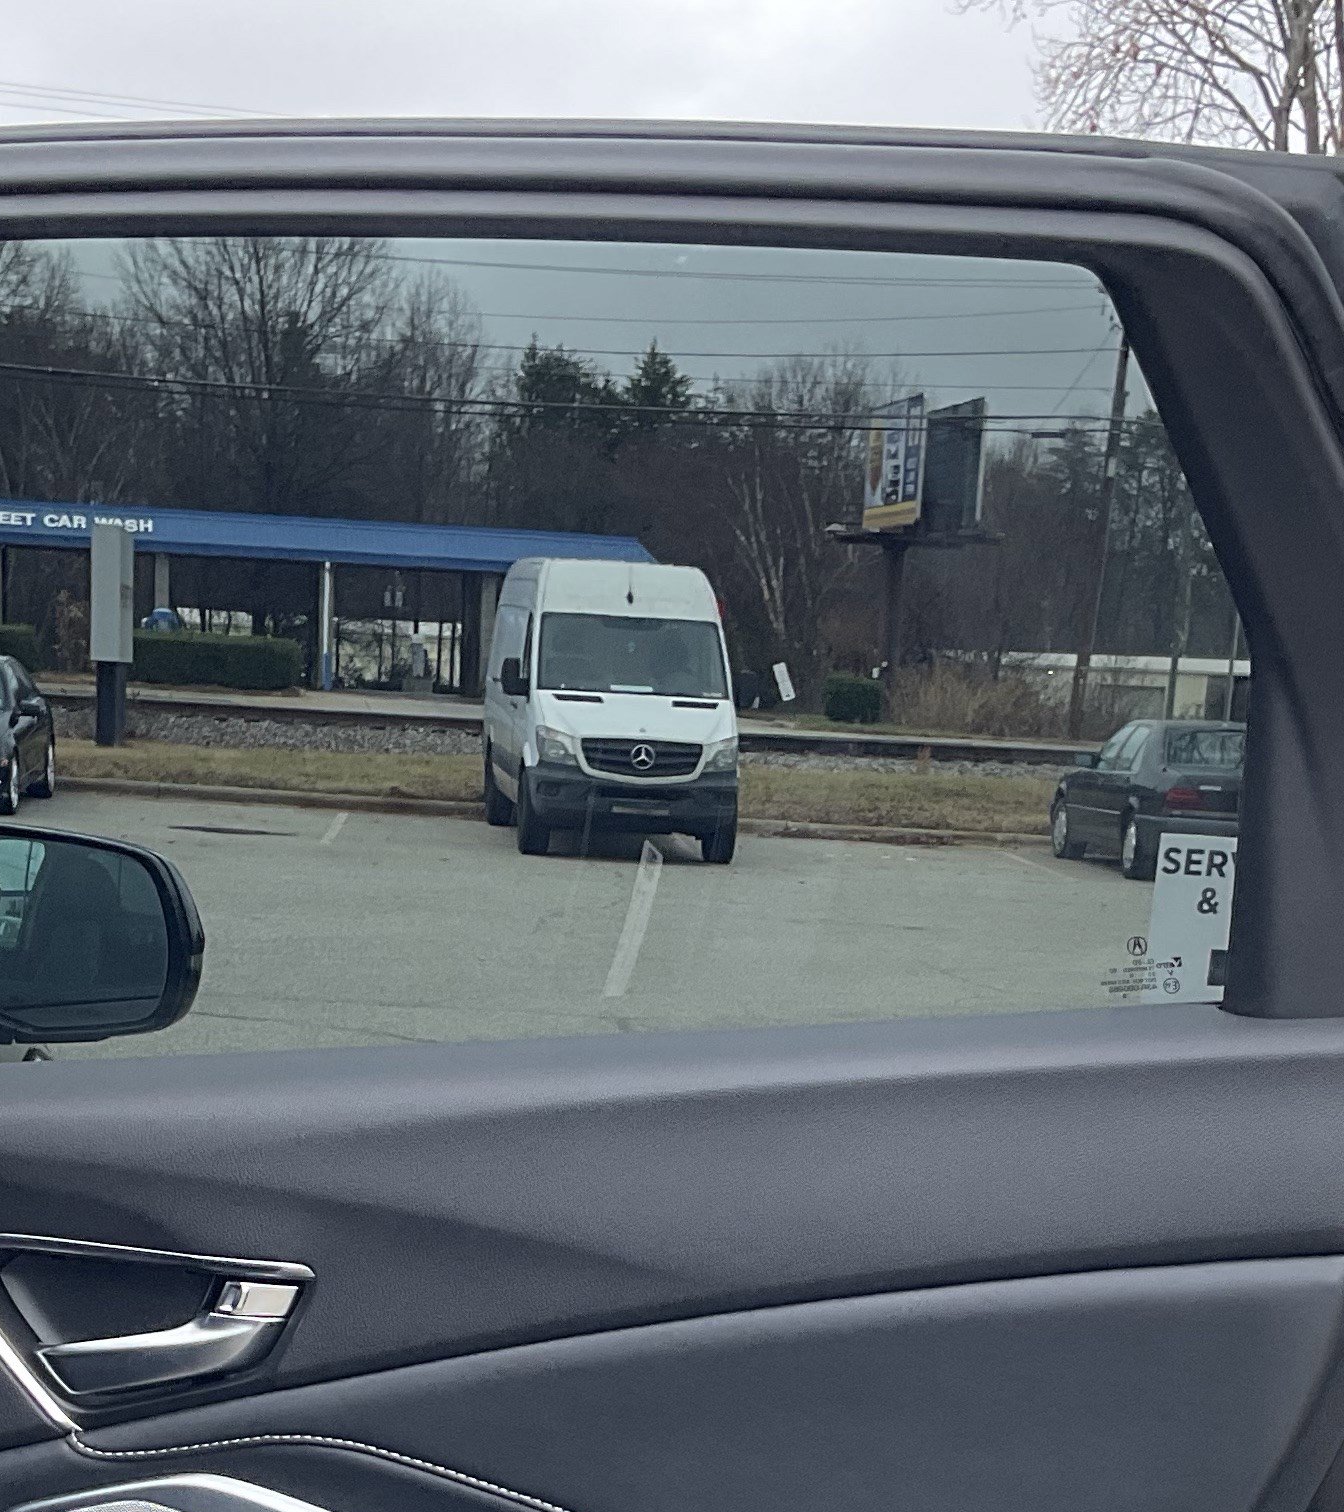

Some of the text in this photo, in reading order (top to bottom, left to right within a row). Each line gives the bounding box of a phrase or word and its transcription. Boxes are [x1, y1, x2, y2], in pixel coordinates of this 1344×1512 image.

[43, 514, 87, 529] CAR
[1162, 847, 1236, 878] SER
[1197, 887, 1219, 915] &
